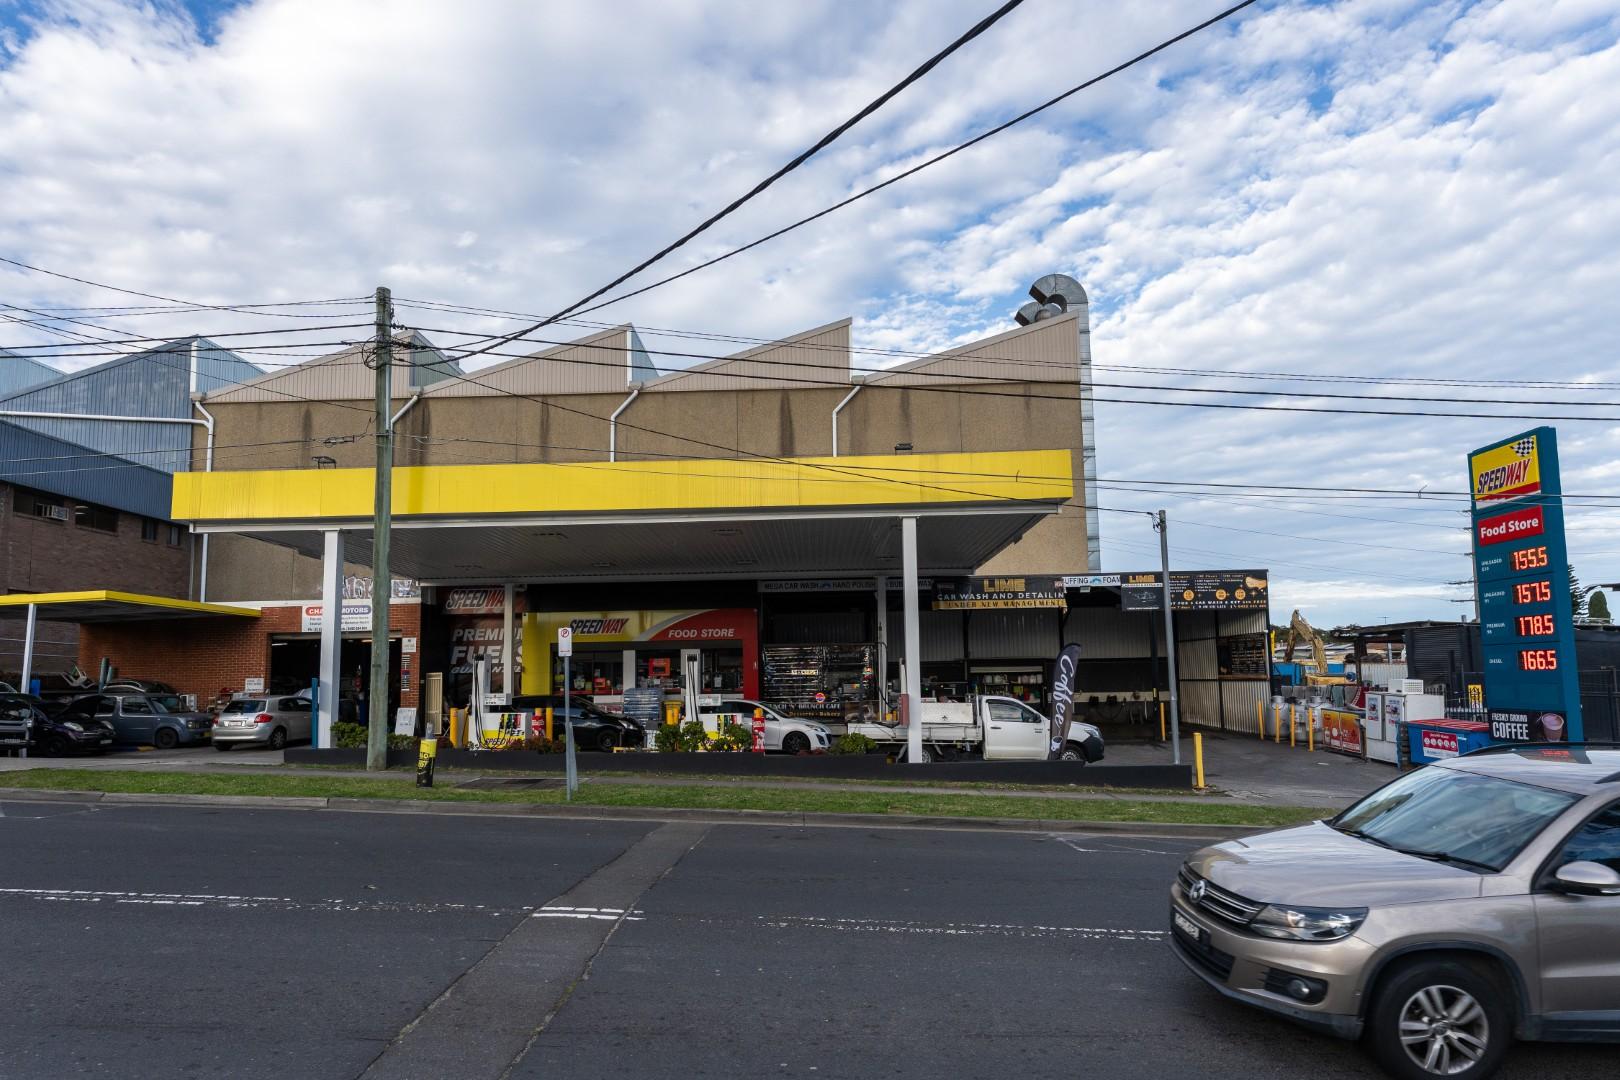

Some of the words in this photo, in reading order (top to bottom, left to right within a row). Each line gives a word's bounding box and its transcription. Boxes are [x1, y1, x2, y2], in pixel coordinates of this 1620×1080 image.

[1477, 458, 1532, 494] SPEEDWAY
[1480, 523, 1507, 539] Food
[1508, 518, 1539, 533] Store
[1481, 558, 1503, 566] UNLEADED
[1513, 546, 1549, 571] 155.5
[446, 589, 505, 609] SPEEDWA
[937, 593, 956, 601] CAR
[960, 592, 989, 600] WASH
[1018, 592, 1065, 600] DETAILIN
[1516, 581, 1551, 604] 157.5
[569, 618, 629, 634] SPEEDWAY
[668, 629, 698, 638] FOOD
[701, 628, 735, 638] STORE
[1519, 614, 1554, 636] 178.5
[1522, 650, 1558, 671] 166.5
[1052, 655, 1075, 729] Coffee
[1493, 721, 1530, 740] COFFEE
